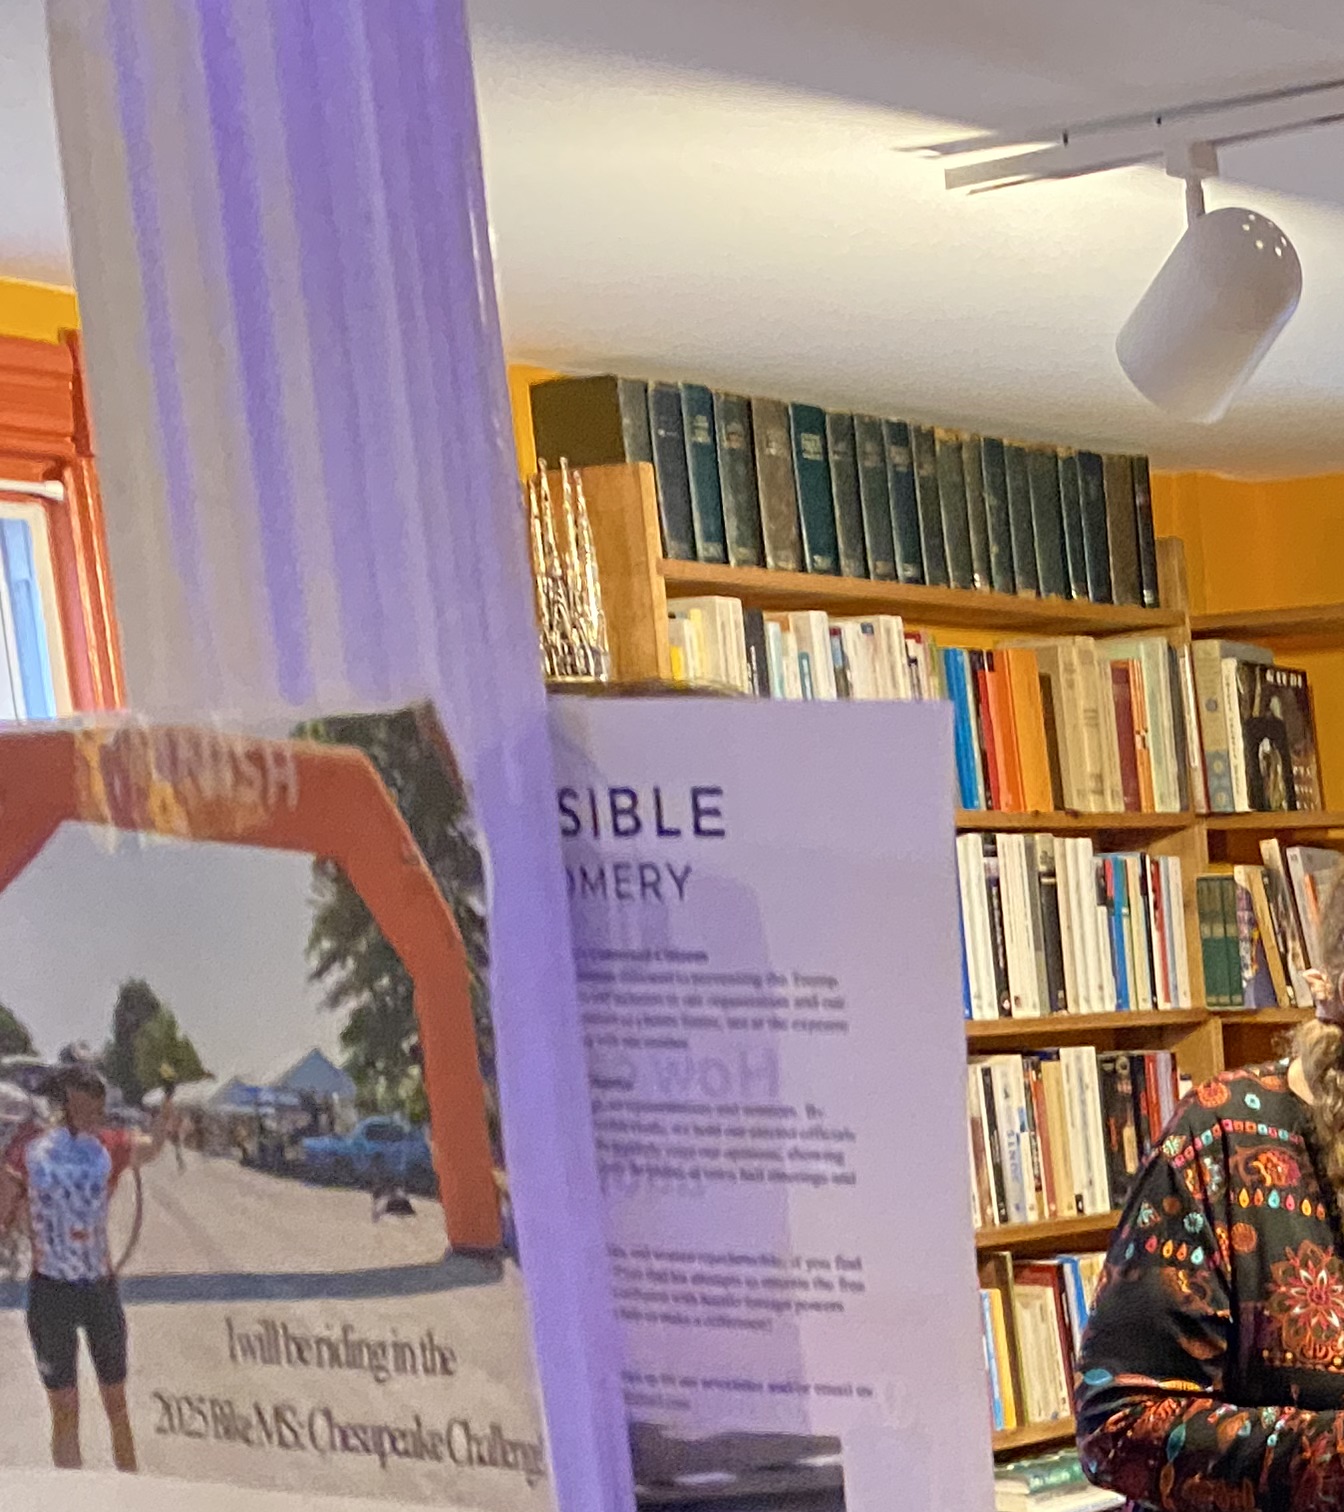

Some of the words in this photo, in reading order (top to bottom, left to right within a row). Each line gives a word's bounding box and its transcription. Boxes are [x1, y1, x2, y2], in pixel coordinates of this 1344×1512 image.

[557, 785, 726, 839] SIBLE
[314, 1322, 389, 1383] riding
[420, 1329, 458, 1377] the
